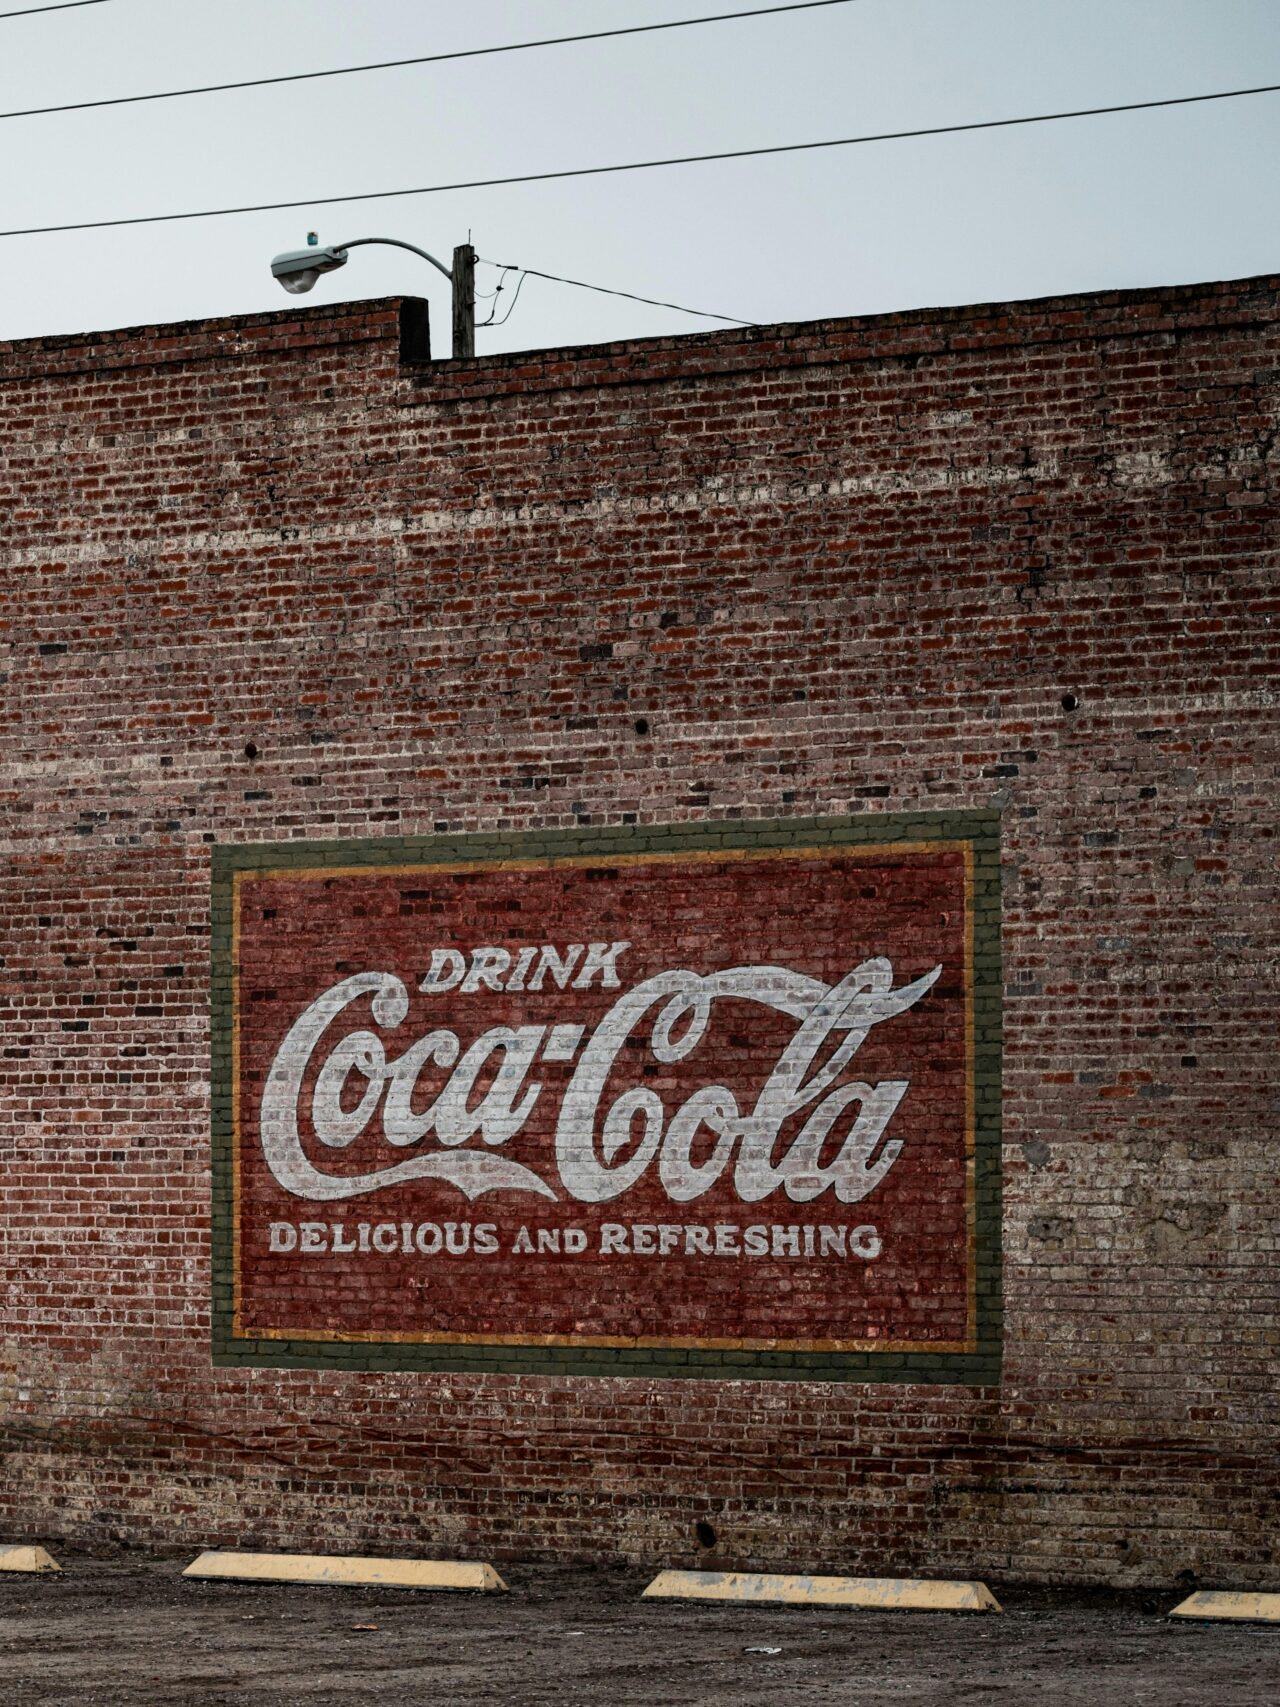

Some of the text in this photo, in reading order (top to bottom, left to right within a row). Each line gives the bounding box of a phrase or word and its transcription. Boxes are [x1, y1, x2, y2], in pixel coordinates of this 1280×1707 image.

[419, 941, 632, 992] DRINK
[261, 957, 942, 1202] Coca-Cola
[269, 1222, 882, 1258] DELICIOUS AND REFRESHING
